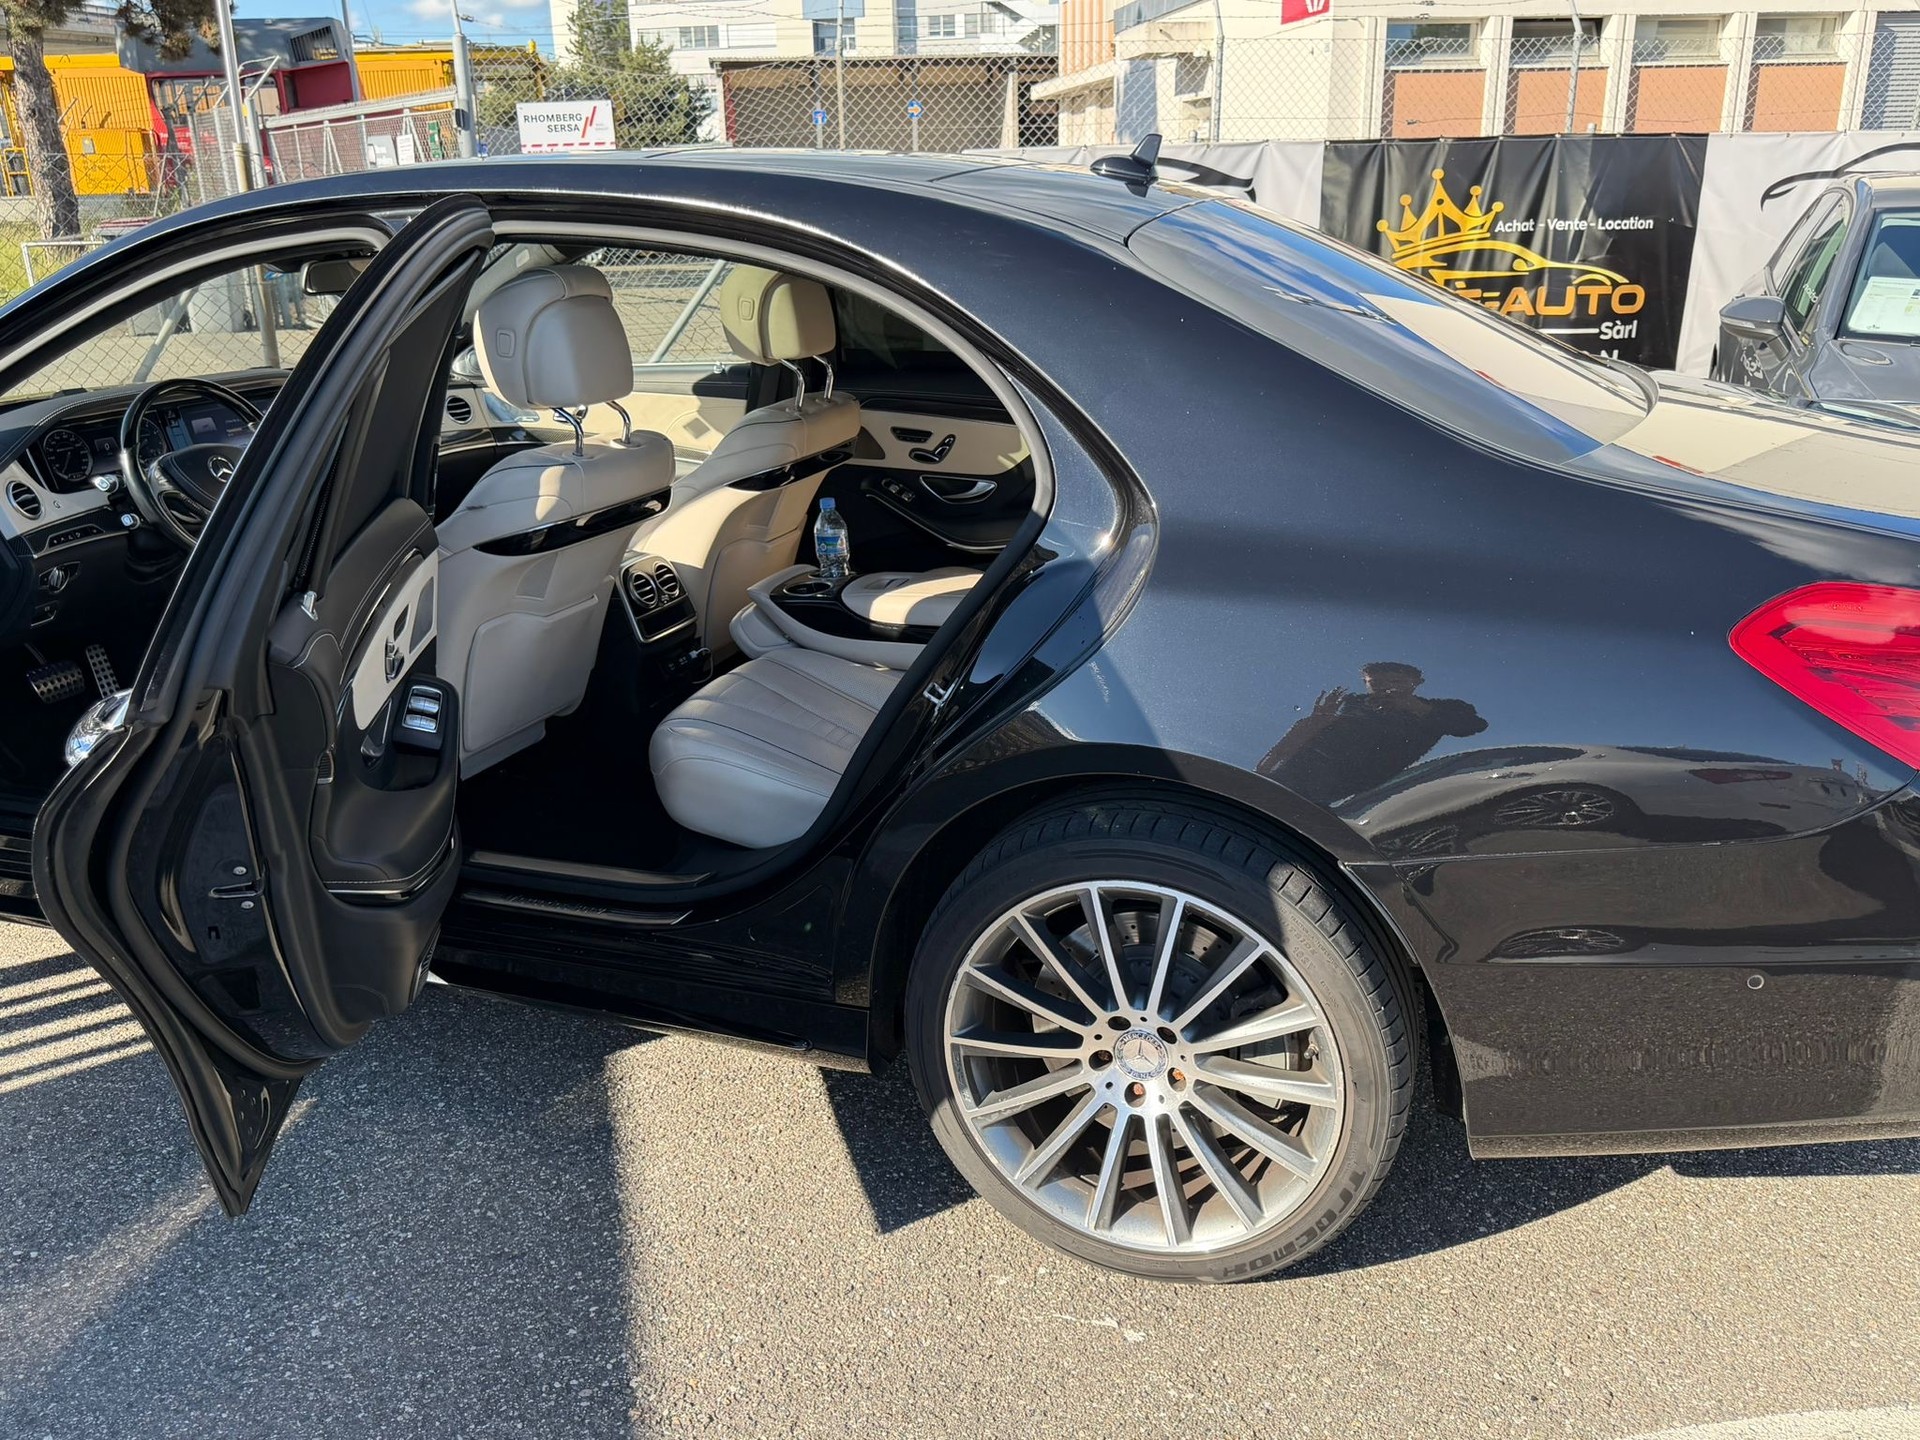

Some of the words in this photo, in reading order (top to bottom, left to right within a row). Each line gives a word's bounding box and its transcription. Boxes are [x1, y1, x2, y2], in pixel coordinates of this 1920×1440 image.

[523, 113, 583, 123] RHOMBERG
[547, 124, 580, 133] SERSA
[1494, 219, 1535, 233] Achat
[1547, 218, 1587, 231] Vente
[1597, 217, 1654, 230] Location
[1599, 320, 1638, 340] Sàrl
